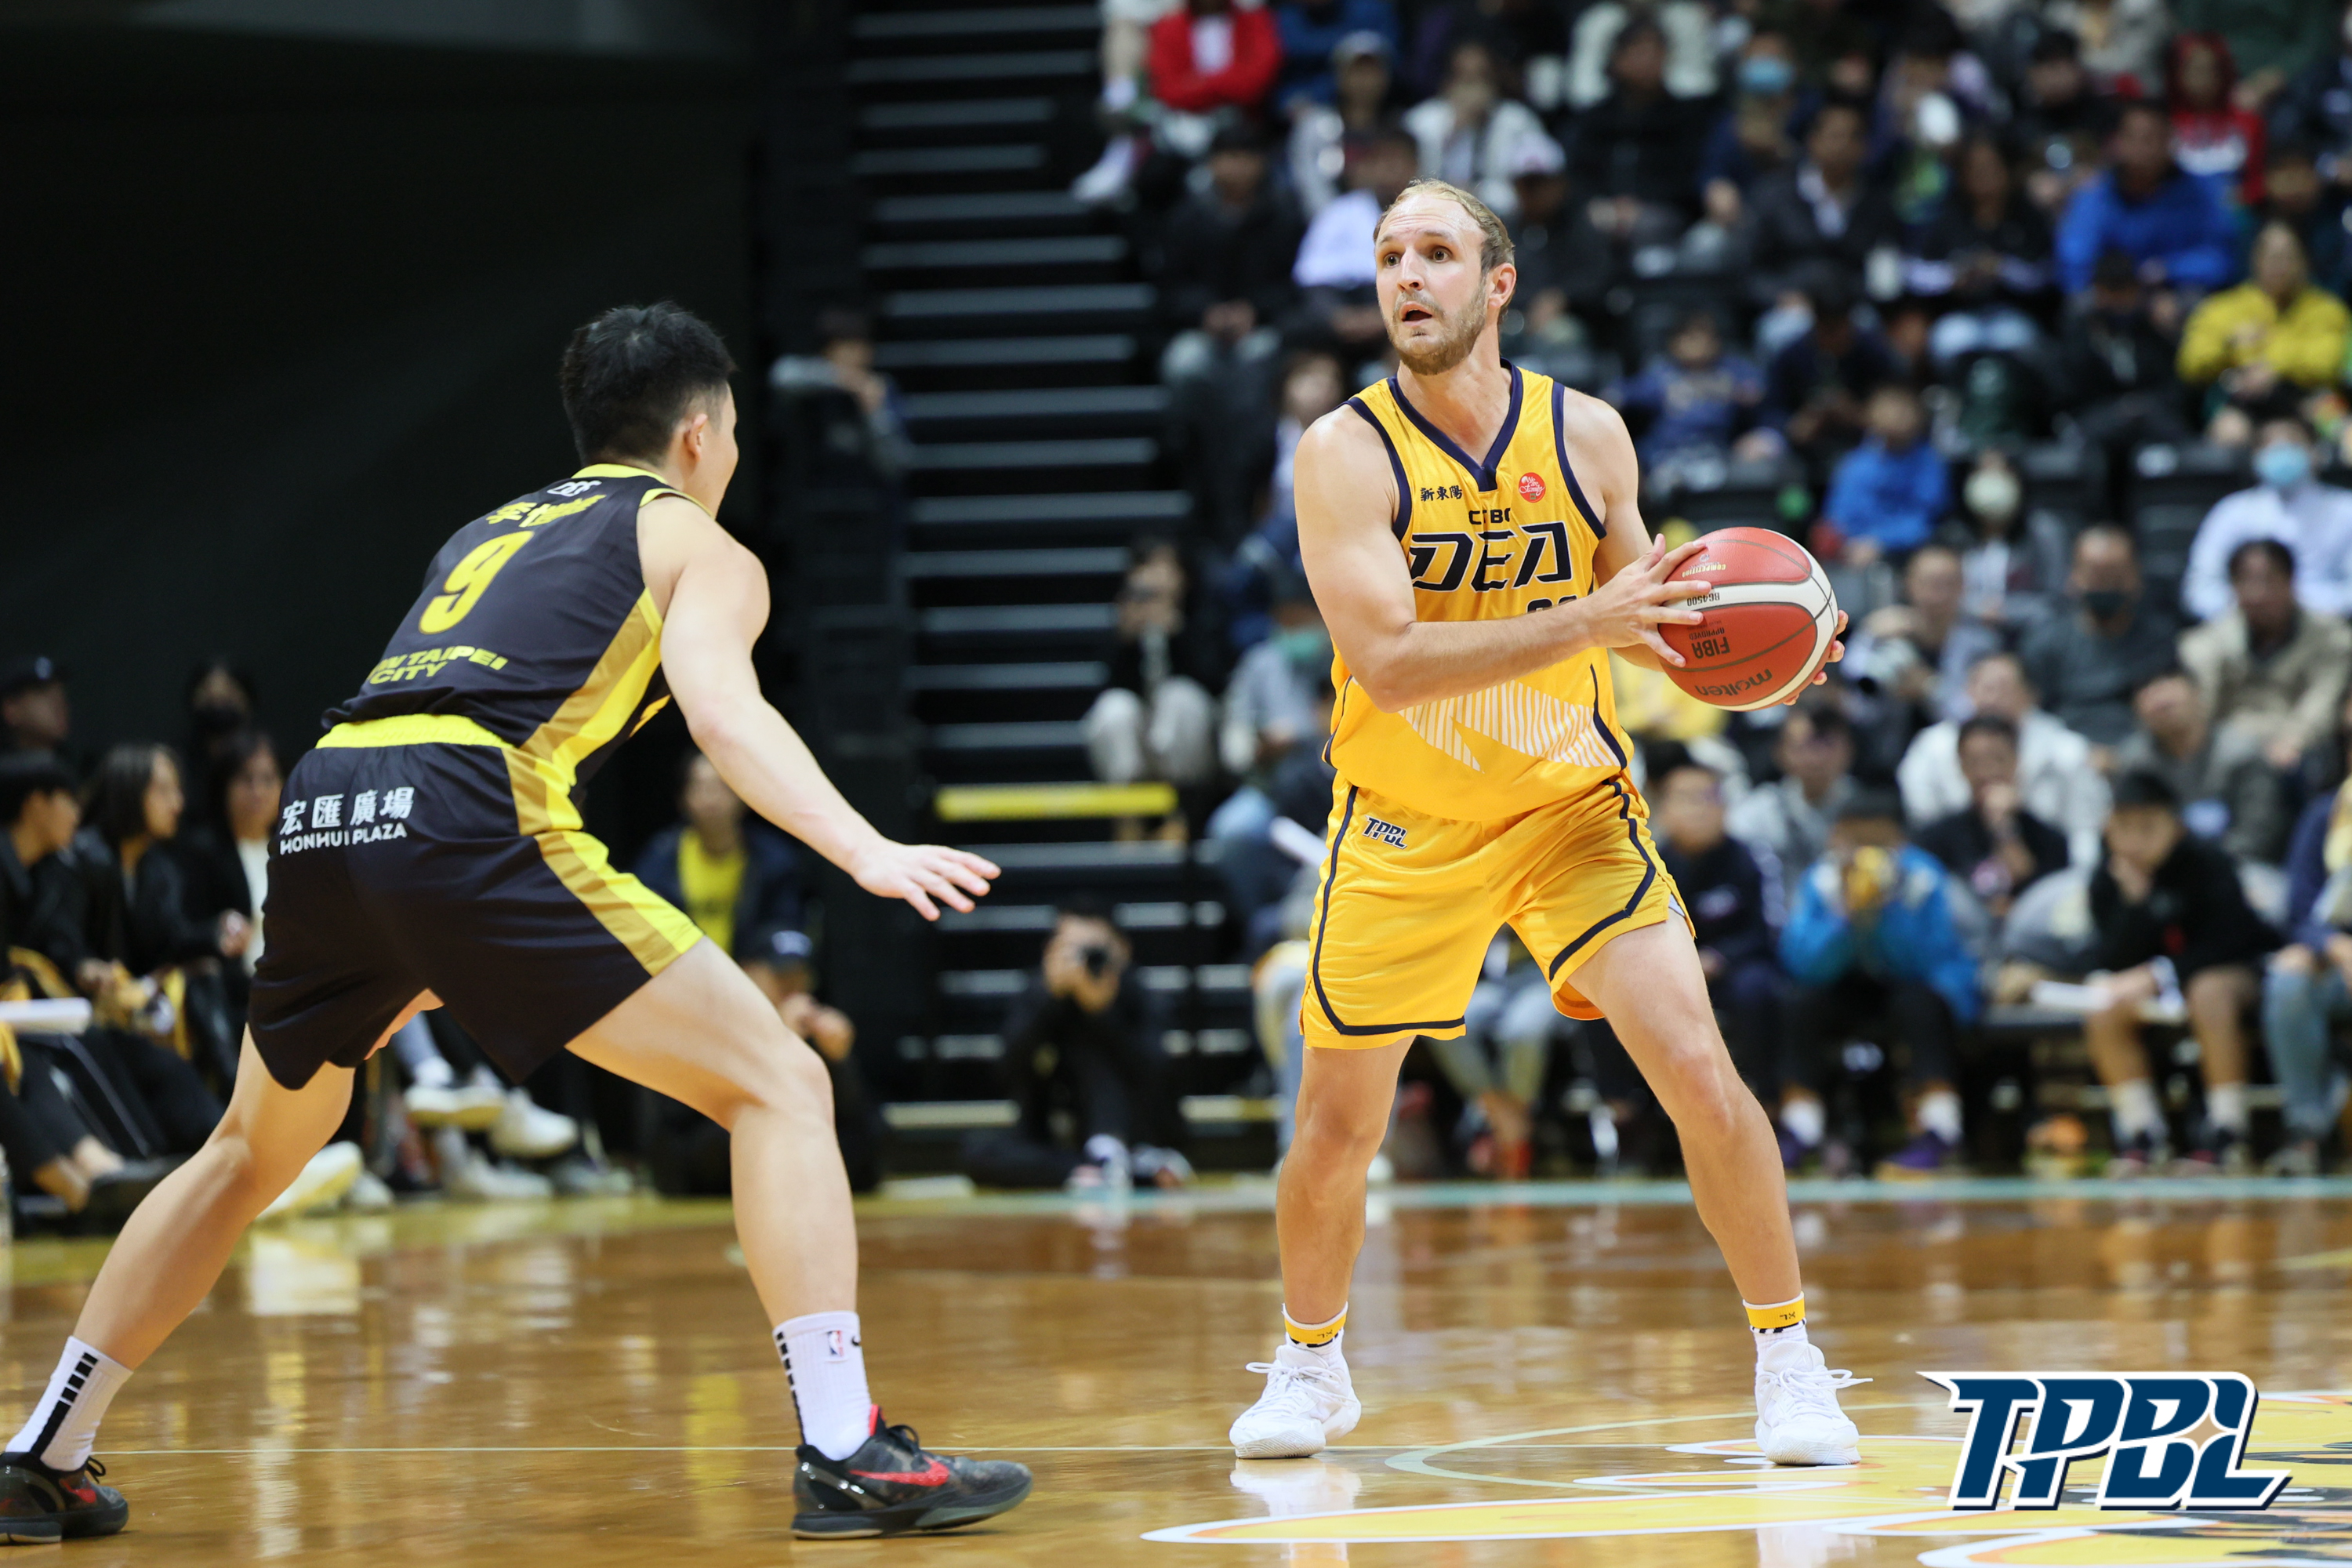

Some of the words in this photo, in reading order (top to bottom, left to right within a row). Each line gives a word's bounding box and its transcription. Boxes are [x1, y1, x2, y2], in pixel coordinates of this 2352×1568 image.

[1420, 485, 1463, 502] 新東陽
[419, 530, 534, 634] 9
[1687, 592, 1720, 607] BG4500
[1689, 627, 1726, 641] APPROVED
[407, 645, 509, 670] TAIPEI
[1691, 636, 1731, 659] FIBA
[369, 661, 448, 684] CITY
[1694, 668, 1773, 696] molten
[279, 786, 416, 836] 宏匯廣場
[280, 829, 350, 855] HONHUI
[352, 822, 408, 845] PLAZA
[1363, 815, 1408, 849] TPBL
